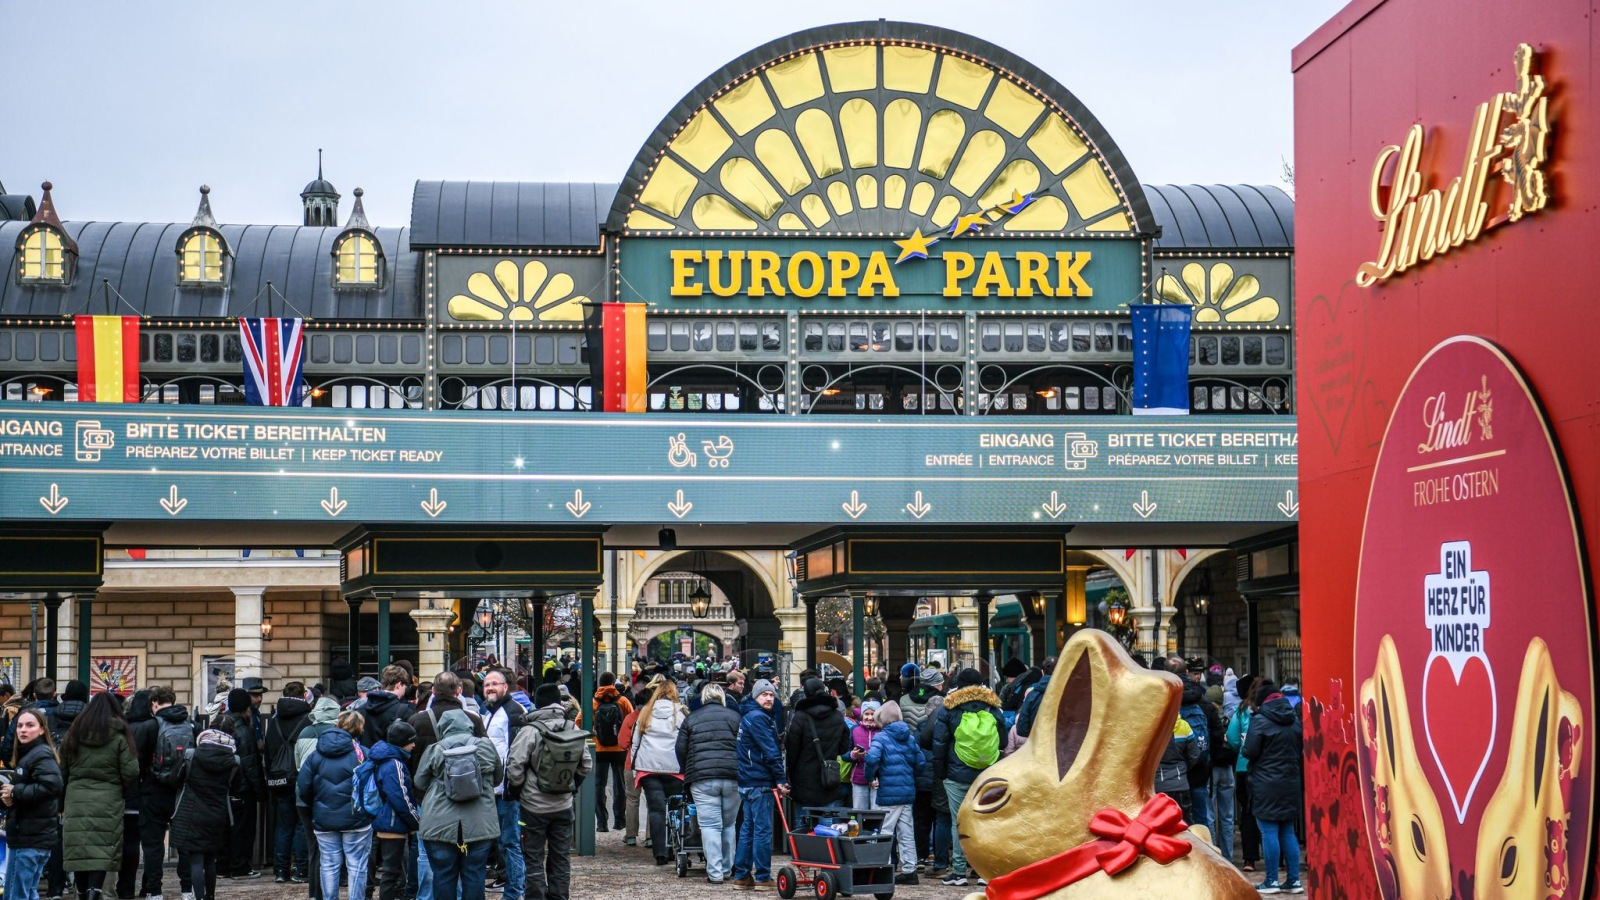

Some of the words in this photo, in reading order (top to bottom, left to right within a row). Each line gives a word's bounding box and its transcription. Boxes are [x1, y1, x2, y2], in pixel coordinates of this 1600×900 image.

[1356, 92, 1504, 287] Lindt
[670, 249, 900, 298] EUROPA
[942, 250, 1093, 298] PARK
[126, 423, 179, 439] BITTE
[184, 424, 249, 441] TICKET
[254, 425, 387, 442] BEREITHALTEN
[1418, 390, 1478, 454] Lindt
[126, 444, 198, 459] PRÉPAREZ
[201, 446, 246, 459] VOTRE
[250, 447, 295, 460] BILLET
[312, 449, 346, 461] KEEP
[350, 449, 396, 462] TICKET
[399, 450, 444, 462] READY
[979, 433, 1055, 448] EINGANG
[1108, 433, 1154, 447] BITTE
[1158, 433, 1217, 447] TICKET
[925, 452, 973, 466] ENTRÉE
[988, 454, 1055, 466] ENTRANCE
[1108, 453, 1171, 466] PRÉPAREZ
[1174, 454, 1215, 465] VOTRE
[1218, 454, 1258, 465] BILLET
[1414, 476, 1450, 506] FROHE
[1452, 468, 1499, 501] OSTERN
[1445, 549, 1466, 580] EIN
[1428, 586, 1458, 617] HERZ
[1461, 578, 1486, 615] FÜR
[1434, 622, 1480, 653] KINDER
